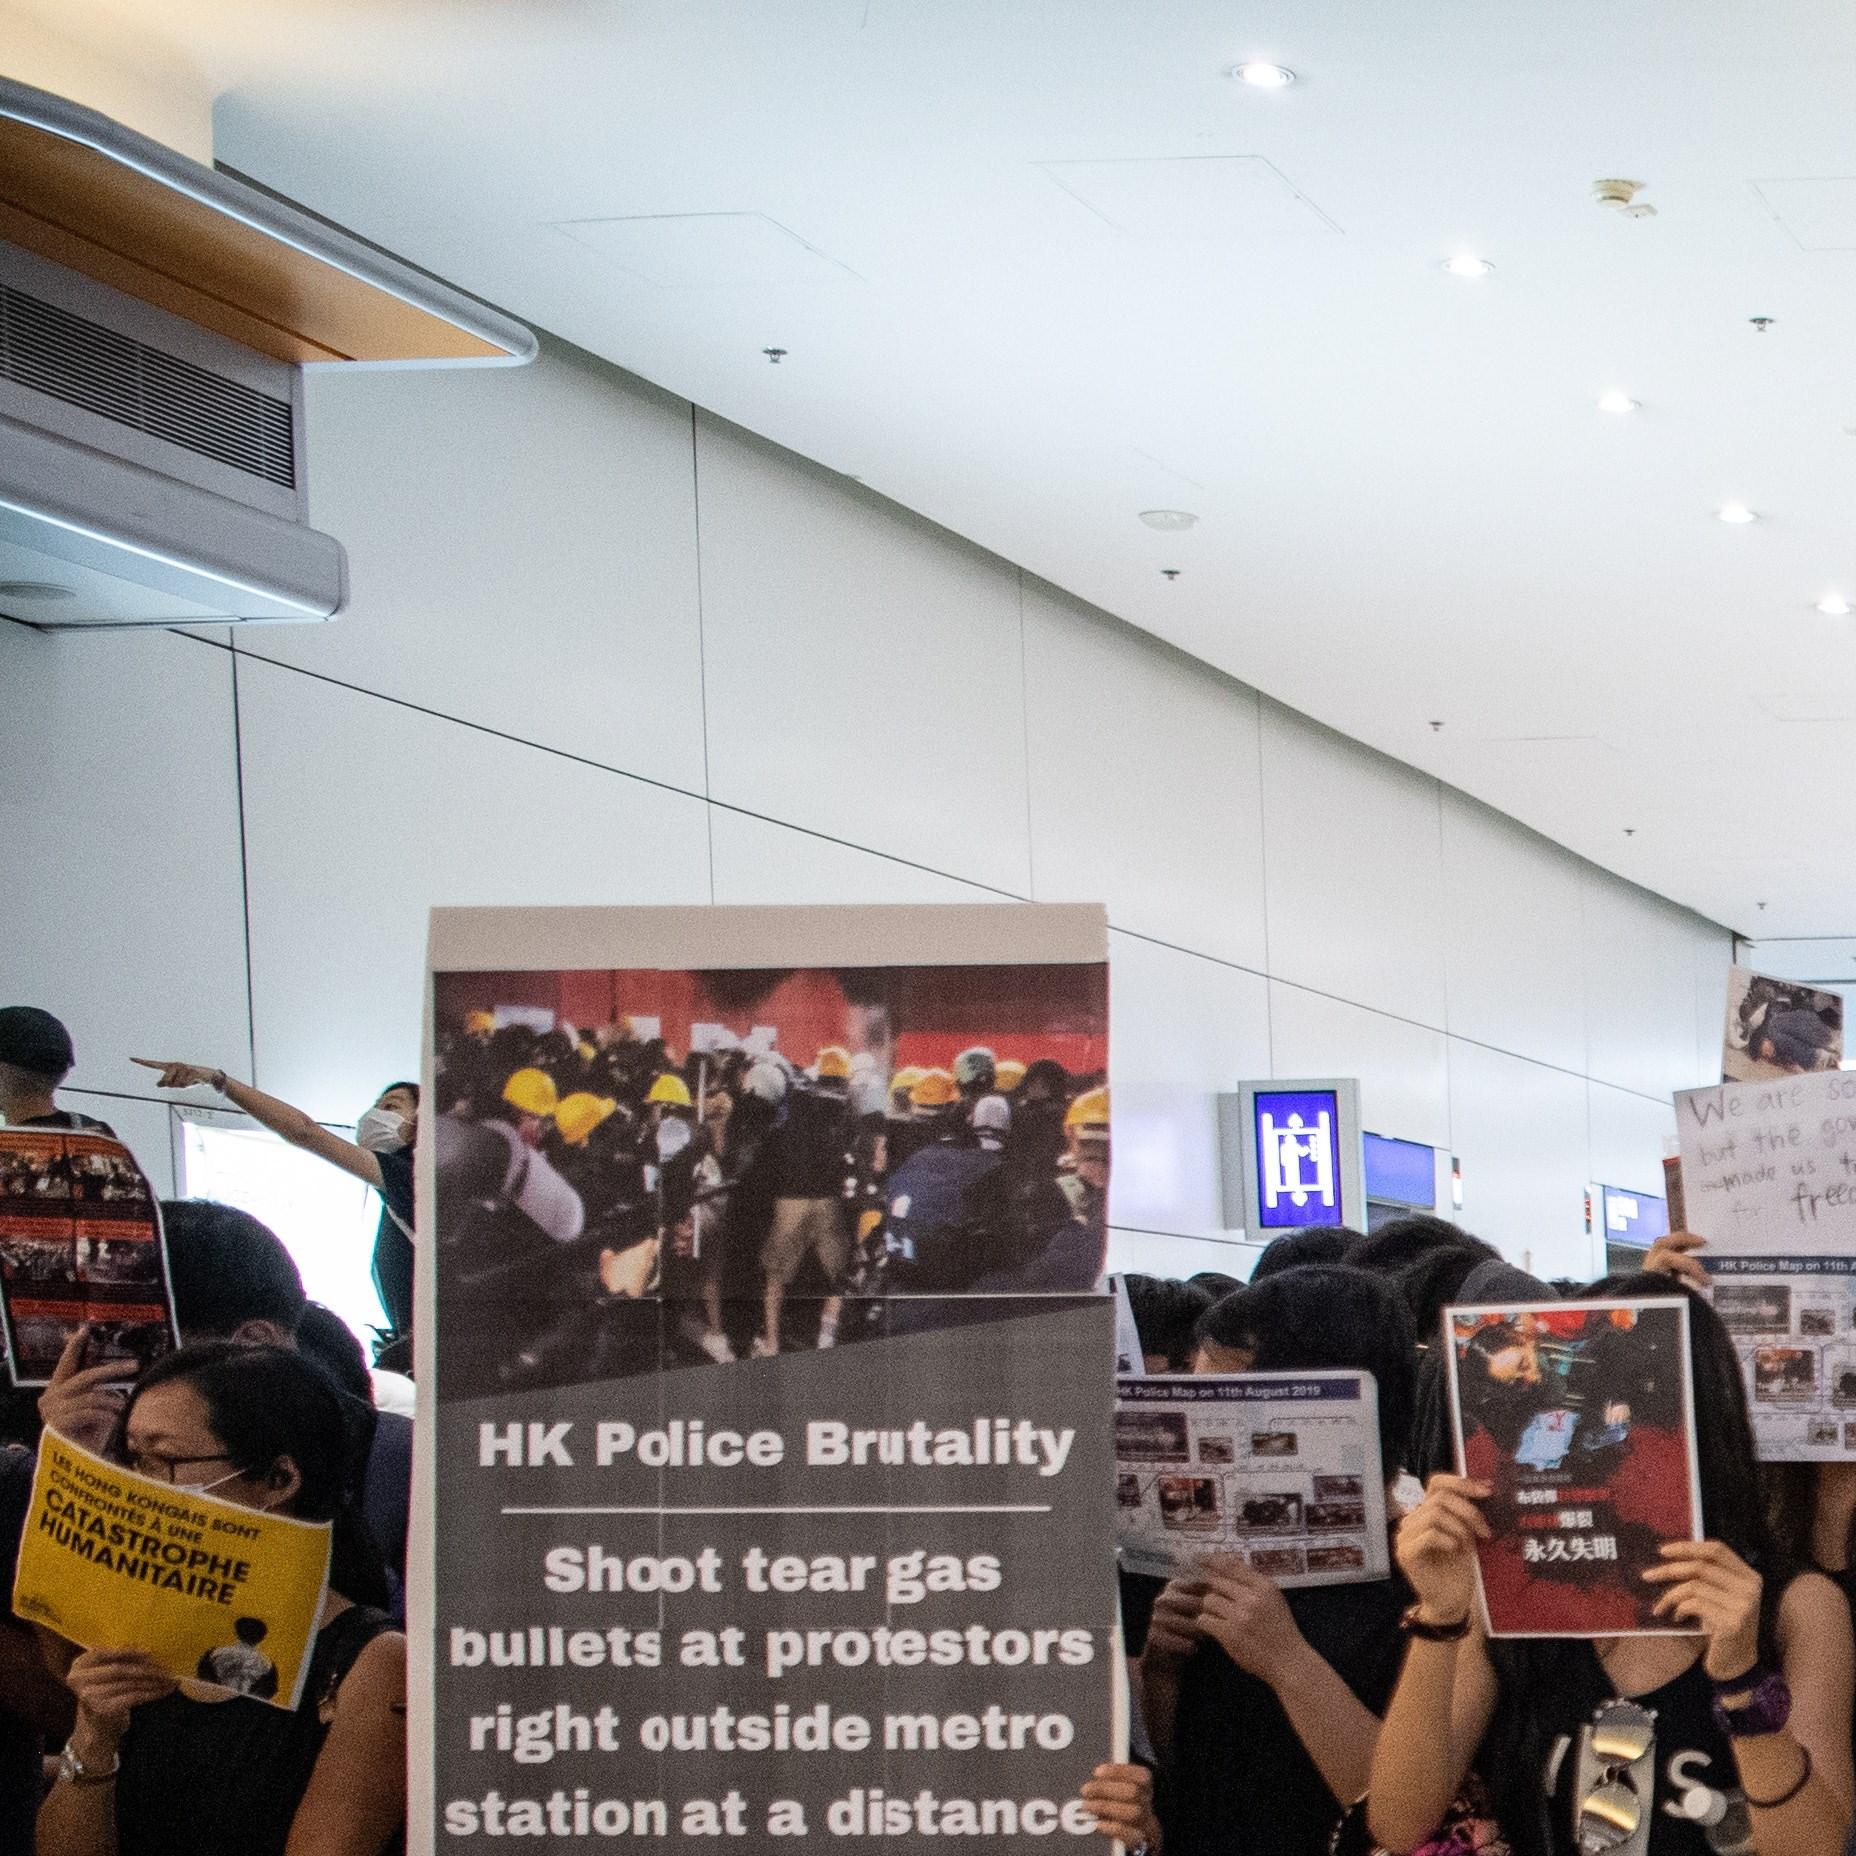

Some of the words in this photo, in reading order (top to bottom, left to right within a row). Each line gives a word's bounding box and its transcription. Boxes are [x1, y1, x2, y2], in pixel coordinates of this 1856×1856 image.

[1690, 1088, 1744, 1129] We
[1756, 1086, 1801, 1111] are
[1701, 1144, 1737, 1167] but
[1753, 1128, 1800, 1151] the
[1792, 1162, 1816, 1176] us
[1741, 1260, 1776, 1272] Police
[1779, 1260, 1799, 1274] Map
[1802, 1263, 1820, 1271] on
[1825, 1260, 1847, 1271] 11th
[1134, 1386, 1169, 1398] Police
[1171, 1386, 1197, 1399] Map
[1200, 1388, 1215, 1397] on
[1217, 1386, 1243, 1397] 11th
[1245, 1386, 1288, 1399] August
[478, 1422, 575, 1467] HK
[596, 1420, 785, 1467] Police
[806, 1419, 1076, 1476] Brutality
[50, 1470, 145, 1527] CONFRONTÉS
[150, 1517, 163, 1534] À
[168, 1525, 203, 1544] UNE
[75, 1460, 121, 1499] HONG
[125, 1488, 208, 1527] KONGAIS
[212, 1517, 262, 1541] SONT
[40, 1510, 236, 1605] HUMANITAIRE
[45, 1488, 250, 1583] CATASTROPHE
[1523, 1536, 1618, 1562] 永久失明
[544, 1546, 722, 1593] Shoot
[743, 1549, 877, 1593] tear
[886, 1550, 1002, 1604] gas
[450, 1625, 662, 1667] bullets
[680, 1625, 745, 1667] at
[766, 1623, 1094, 1678] protestors
[468, 1704, 620, 1764] right
[640, 1704, 871, 1752] outside
[885, 1705, 1075, 1752] metro
[445, 1789, 667, 1837] station
[681, 1792, 747, 1837] at
[768, 1802, 808, 1837] a
[827, 1789, 1100, 1837] distance
